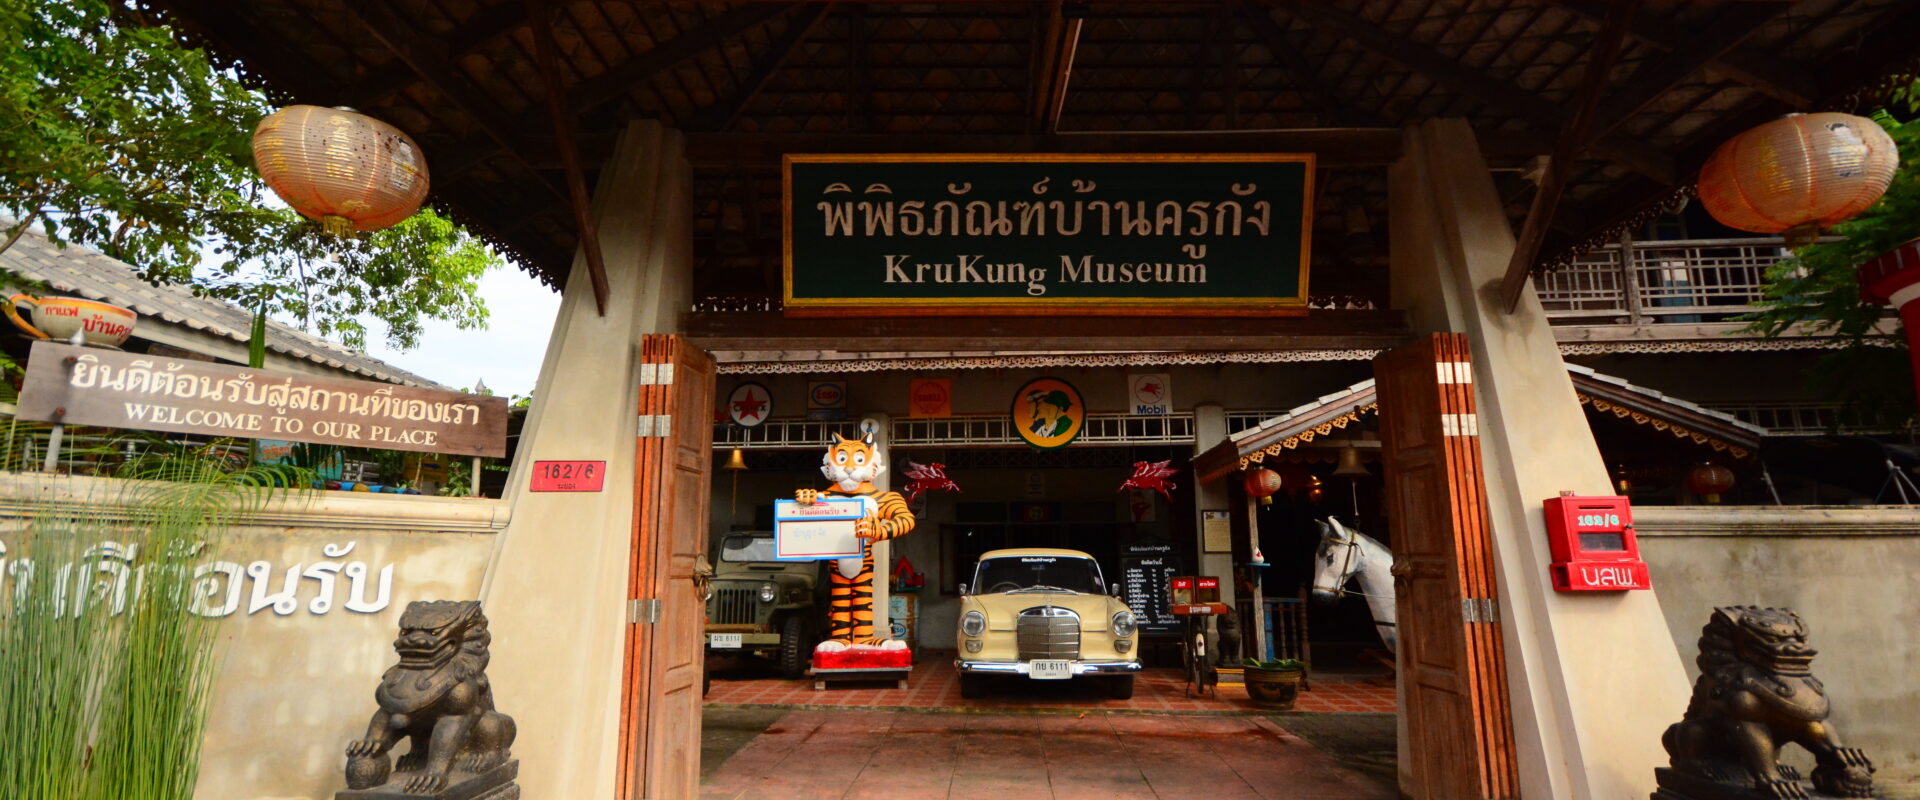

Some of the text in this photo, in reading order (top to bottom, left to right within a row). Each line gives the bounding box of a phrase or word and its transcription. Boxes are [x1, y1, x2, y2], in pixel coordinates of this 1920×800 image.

[816, 176, 1272, 258] พิพิธภัณฑ์บ้านครูกัง
[883, 254, 1208, 295] KruKung Museum
[45, 306, 79, 317] กาแฟ
[70, 354, 481, 426] ยินดีต้อนรับสู่สถานที่ของเรา
[1136, 404, 1167, 414] Mobil
[124, 402, 437, 446] WELCOME TO OUR PLACE
[544, 463, 595, 479] 162/6
[1577, 513, 1620, 528] 162/6
